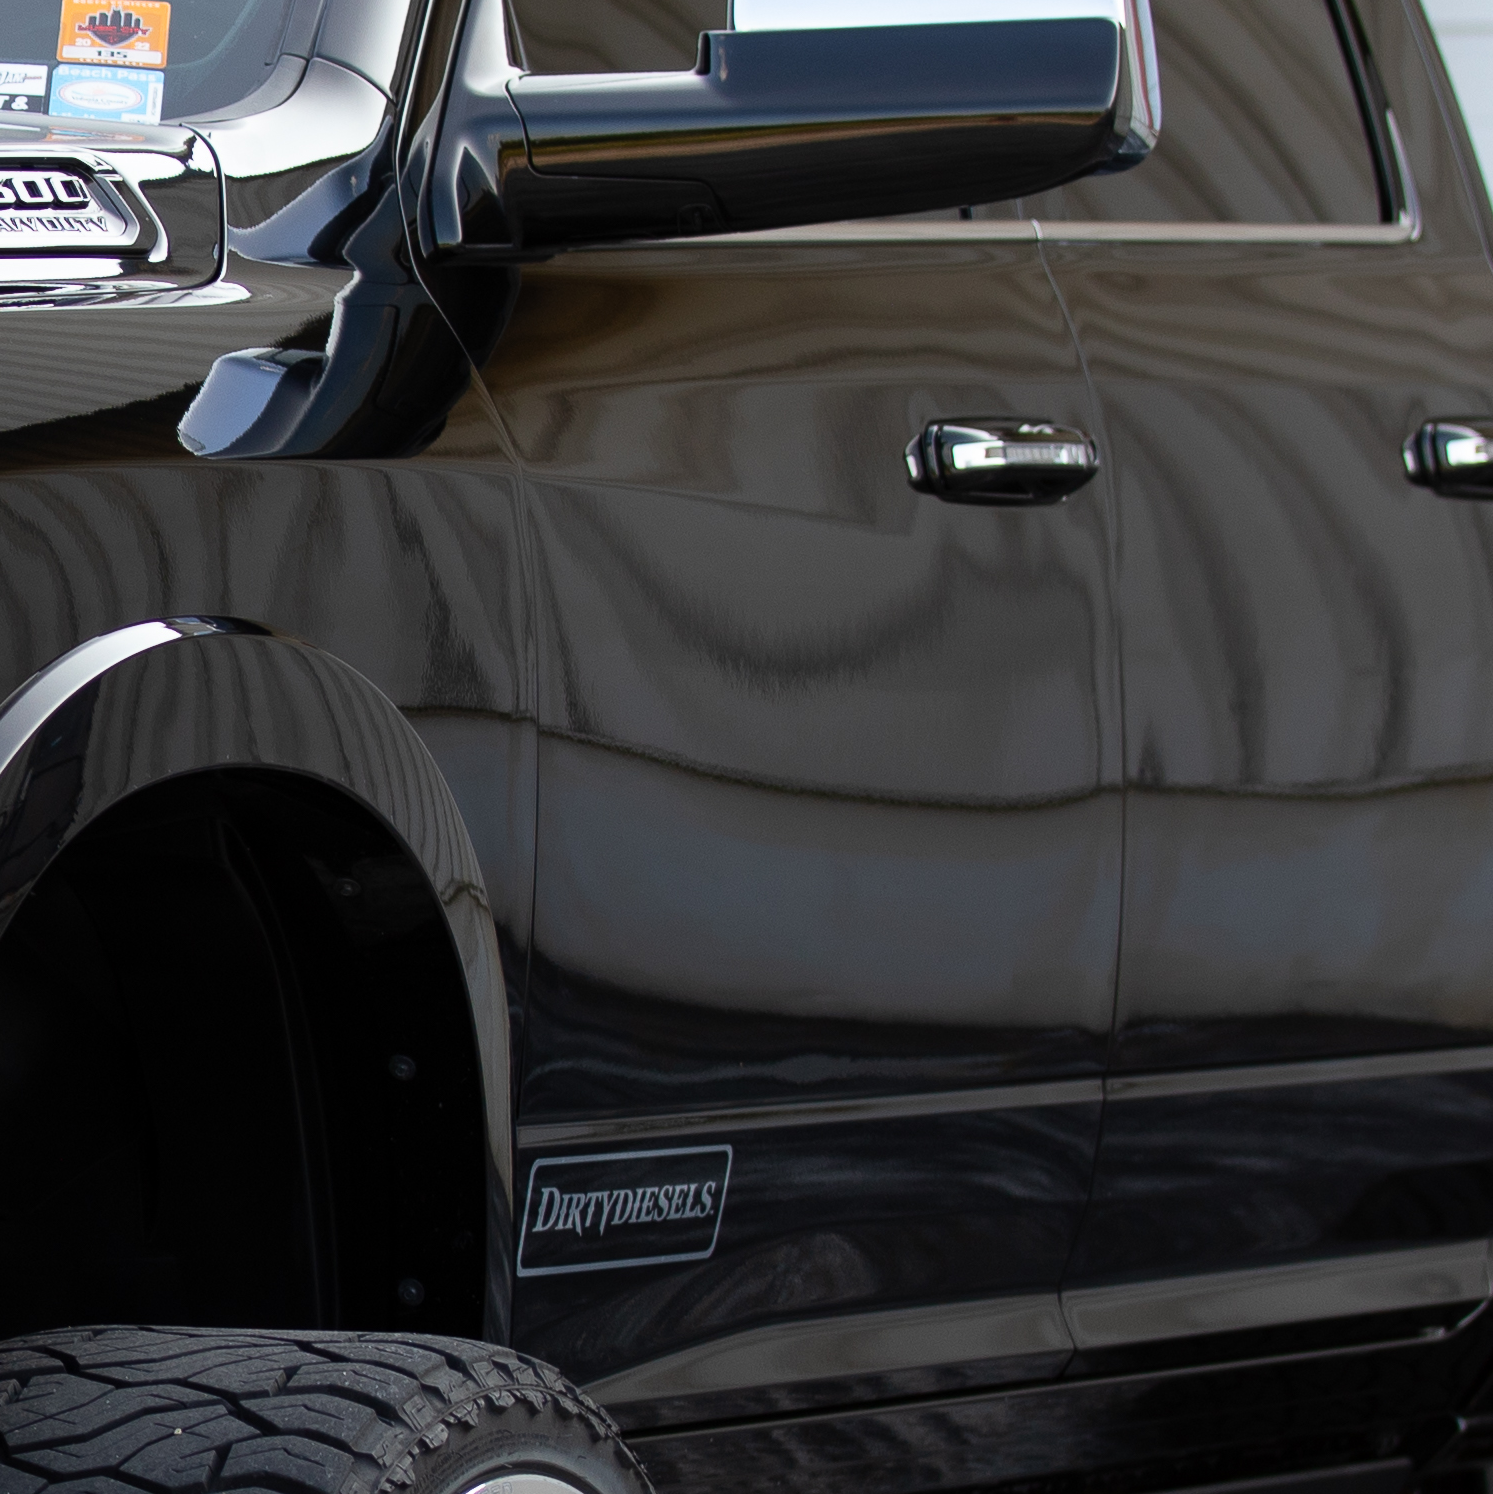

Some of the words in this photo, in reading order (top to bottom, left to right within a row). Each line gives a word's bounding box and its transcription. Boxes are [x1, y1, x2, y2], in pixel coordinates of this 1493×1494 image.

[58, 64, 112, 78] Beach
[117, 70, 157, 82] Pass
[38, 215, 109, 233] DUTY
